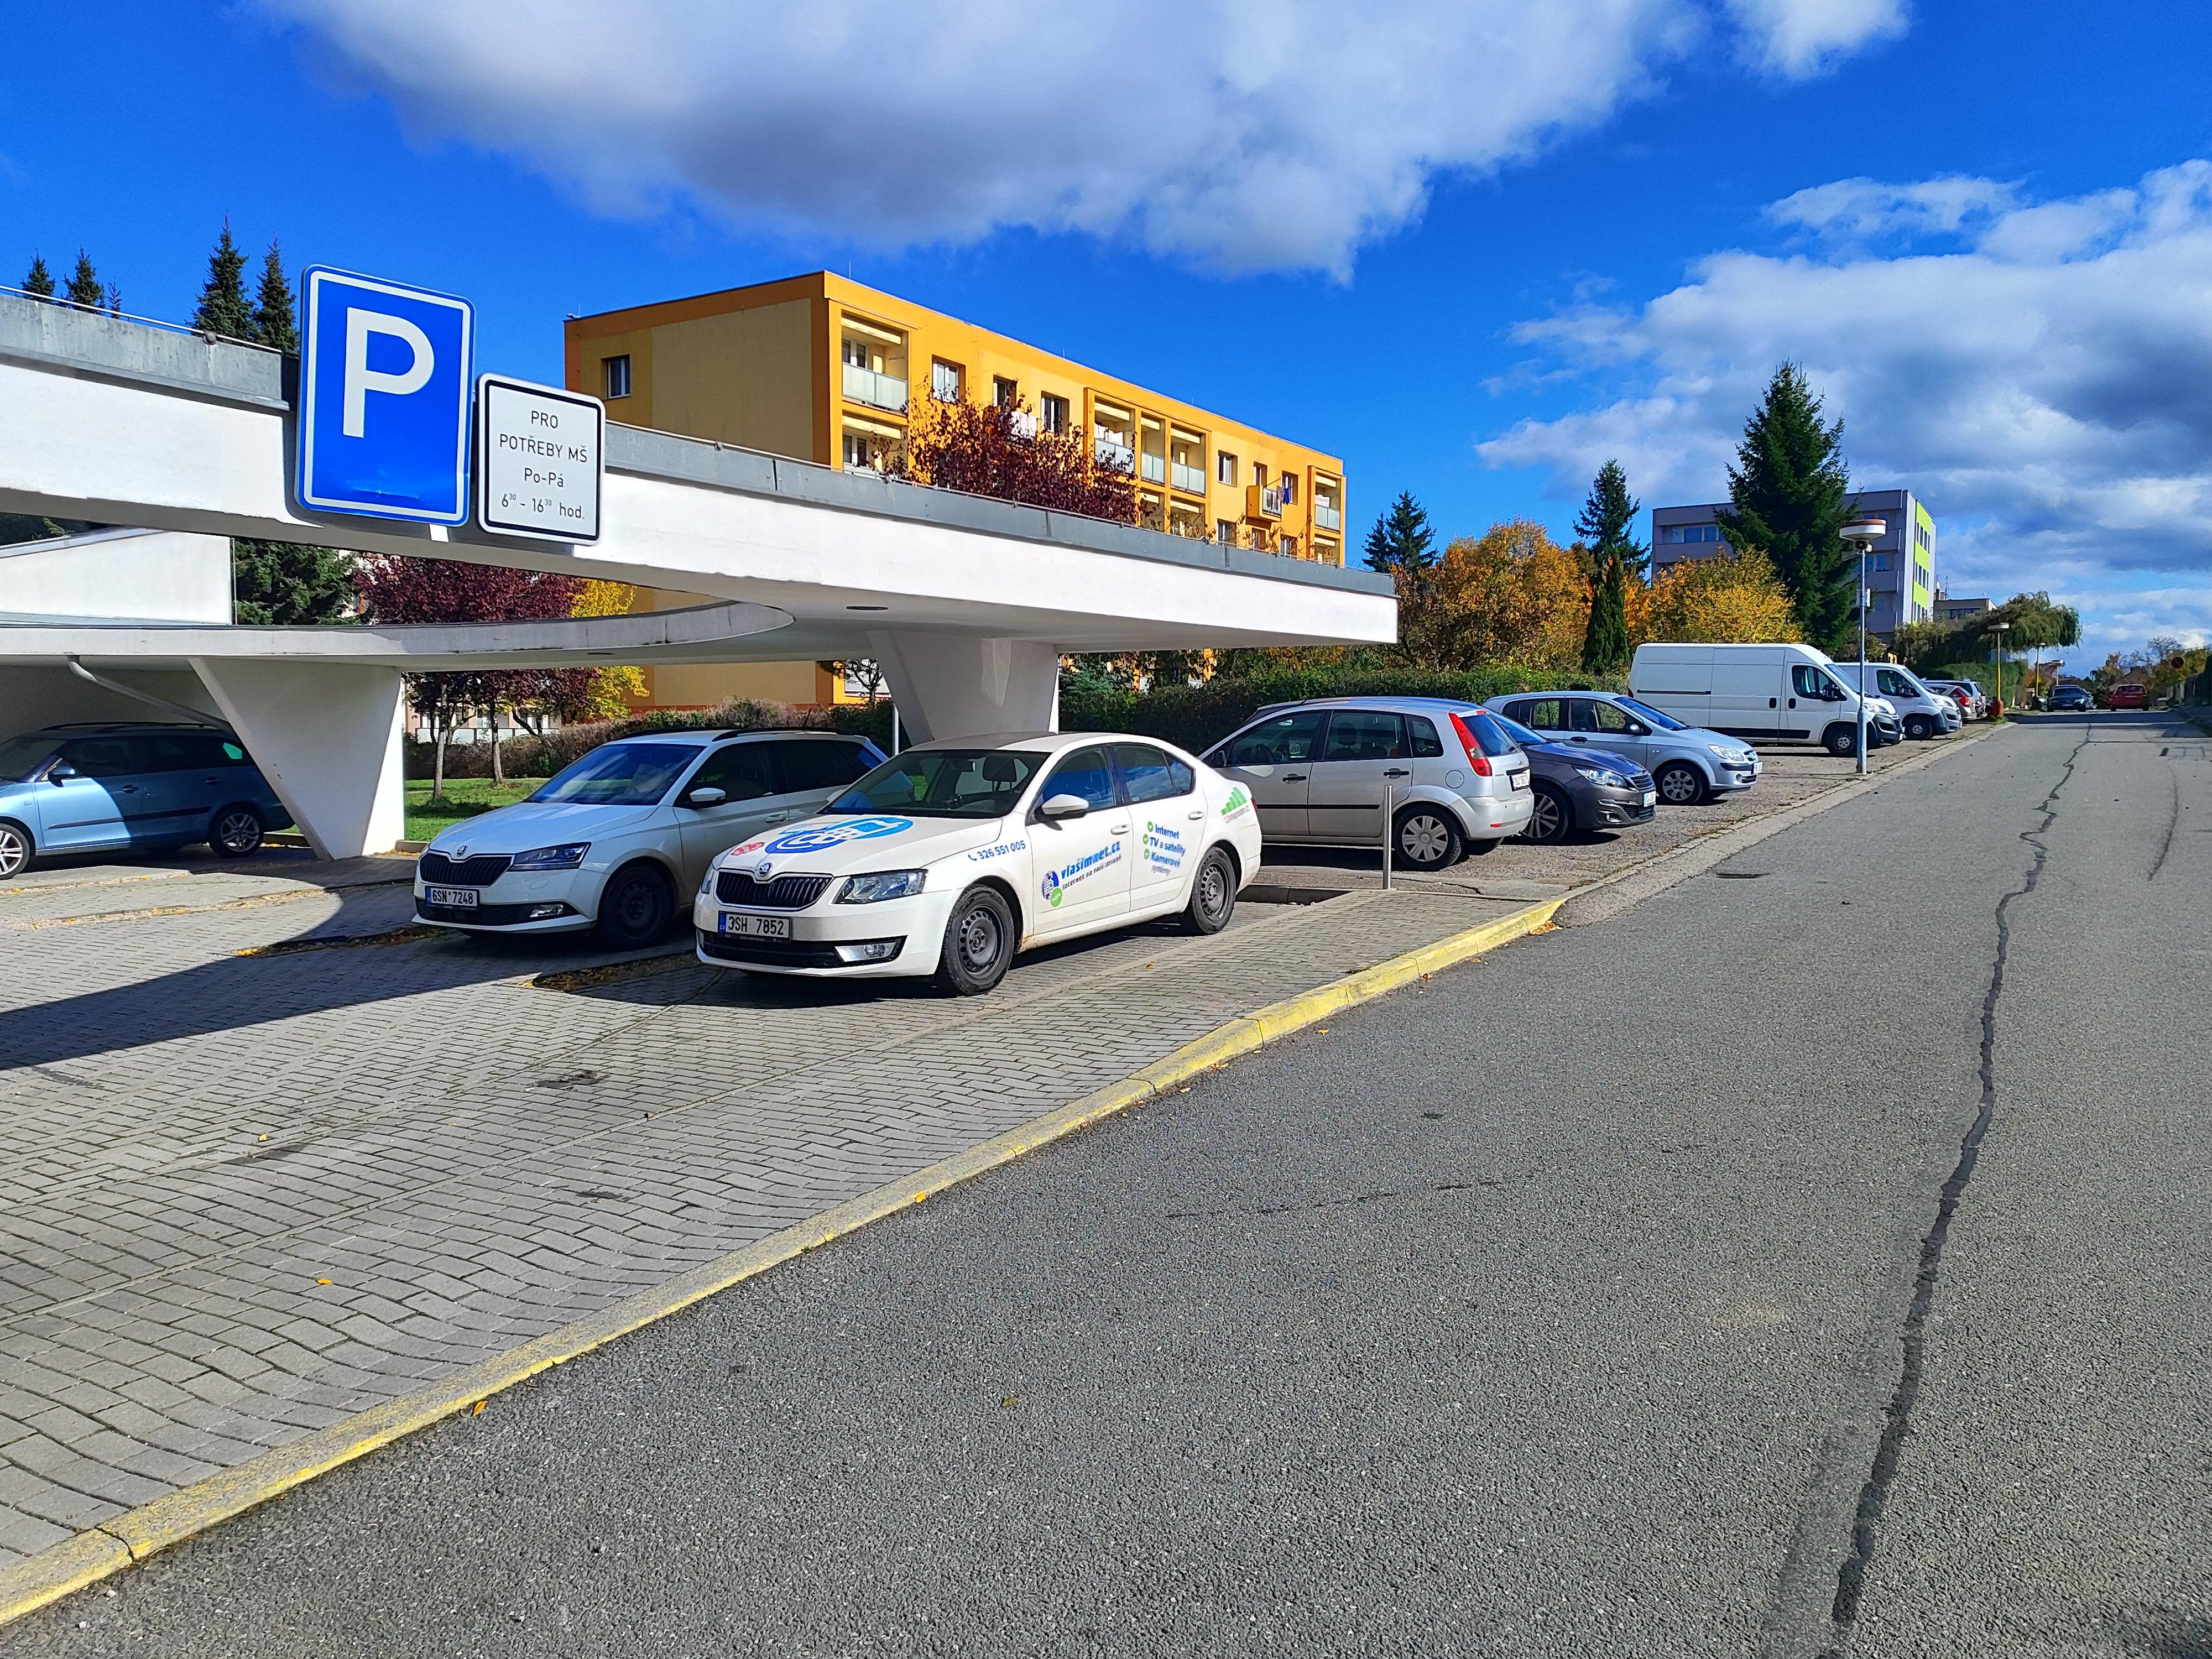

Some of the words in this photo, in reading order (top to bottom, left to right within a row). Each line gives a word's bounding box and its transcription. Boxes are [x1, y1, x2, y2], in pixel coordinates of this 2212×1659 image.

[343, 307, 435, 438] P
[531, 410, 559, 429] PRO
[499, 434, 563, 458] POTŘEBY
[568, 445, 587, 463] MŠ
[524, 468, 564, 488] Po-Pá
[559, 502, 585, 519] hod.
[1155, 823, 1179, 839] Internet
[977, 849, 994, 859] 326
[995, 845, 1009, 855] 551
[1010, 840, 1026, 852] 005
[1150, 837, 1159, 847] TV
[1165, 843, 1186, 857] satelity
[1151, 852, 1181, 868] Kamerové
[432, 889, 447, 903] 6SN
[453, 891, 473, 905] 7248
[728, 916, 748, 932] 3SH
[756, 919, 784, 936] 7852
